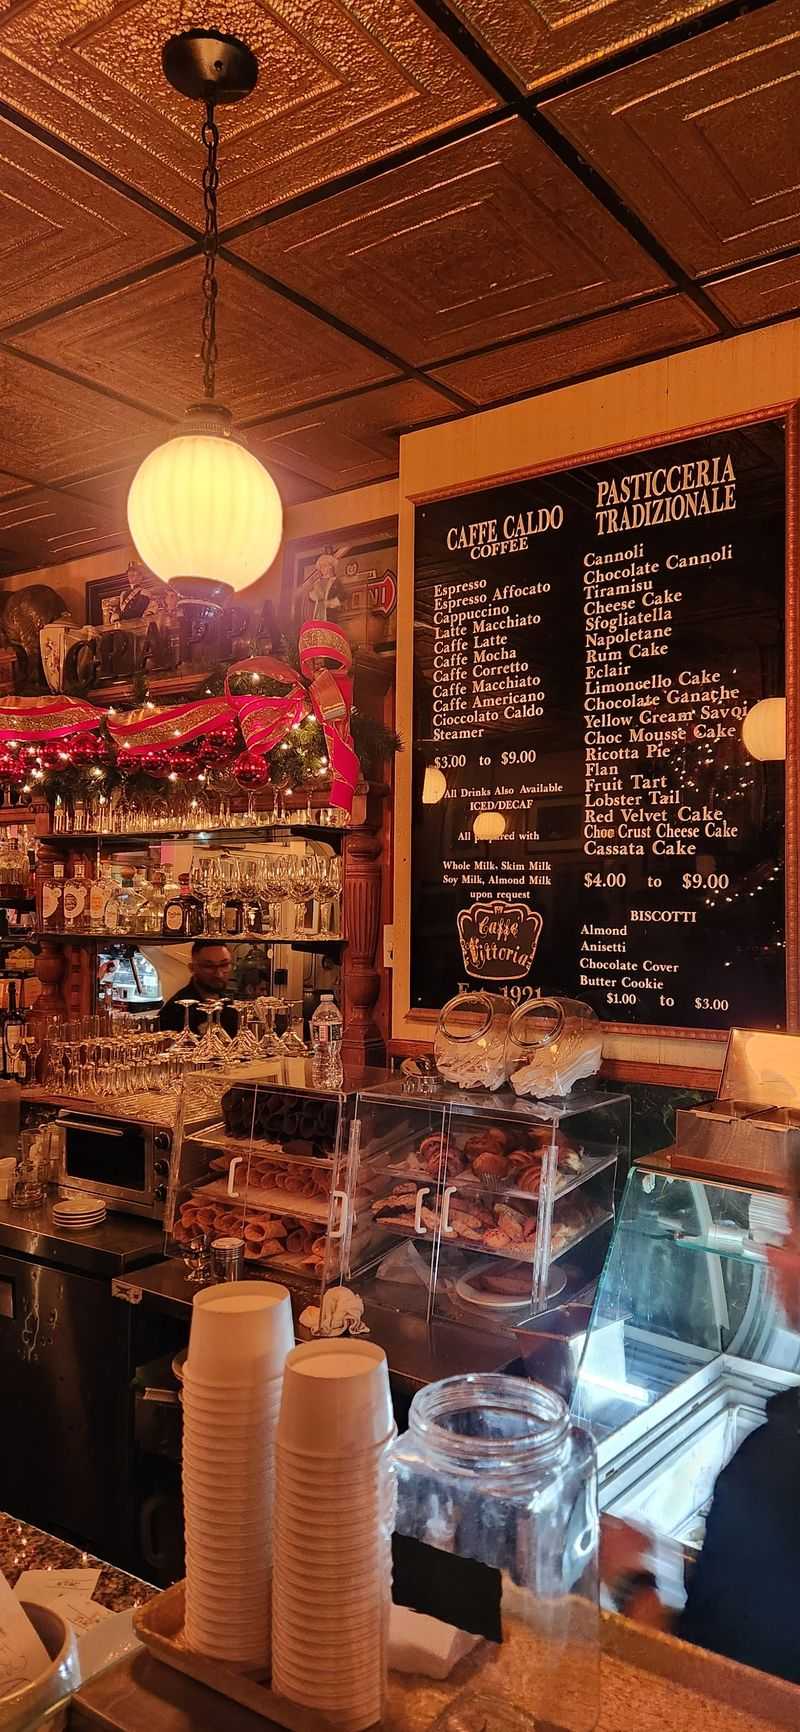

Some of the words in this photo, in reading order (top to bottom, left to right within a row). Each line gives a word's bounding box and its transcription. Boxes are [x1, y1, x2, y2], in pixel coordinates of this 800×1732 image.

[596, 454, 736, 508] PASTICCERIA
[595, 484, 736, 535] TRADIZIONALE
[447, 520, 497, 550] CAFFE
[503, 505, 563, 539] CALDO
[470, 537, 528, 559] COFFEE
[584, 543, 644, 567] Cannoli
[584, 562, 660, 585] Chocolate
[666, 544, 733, 570] Cannoli
[434, 580, 486, 599] Espresso
[434, 594, 487, 613] Espresso
[492, 582, 550, 600] Affocato
[584, 579, 653, 600] Tiramisu
[584, 600, 635, 616] Cheese
[642, 590, 682, 607] Cake
[434, 604, 509, 627] Cappuccino
[585, 607, 673, 633] Sfogliatella
[435, 626, 467, 639] Latte
[473, 614, 541, 633] Macchiato
[434, 638, 468, 654] Caffe
[474, 635, 507, 648] Latte
[585, 626, 673, 650] Napoletane
[433, 653, 468, 668] Caffe
[473, 648, 516, 663] Mocha
[586, 650, 622, 664] Rum
[629, 642, 668, 658] Cake
[433, 668, 467, 682] Caffe
[472, 662, 529, 677] Corretto
[585, 662, 631, 680] Eclair
[433, 683, 467, 698] Caffe
[472, 675, 540, 693] Macchiato
[585, 674, 672, 695] Limoncello
[678, 669, 721, 686] Cake
[433, 698, 467, 712] Caffe
[472, 692, 545, 708] Americano
[584, 694, 660, 712] Chocolate
[666, 685, 740, 704] Ganache
[433, 711, 499, 726] Cioccolato
[504, 704, 543, 719] Caldo
[584, 713, 633, 729] Yellow
[639, 710, 693, 725] Cream
[433, 728, 484, 741] Steamer
[584, 731, 622, 745] Choc
[629, 728, 687, 743] Mousse
[694, 723, 736, 739] Cake
[434, 755, 466, 768] $3.00
[480, 756, 491, 766] to
[501, 750, 536, 765] $9.00
[585, 747, 639, 762] Ricotta
[646, 744, 671, 759] Pie
[585, 763, 619, 777] Flan
[444, 789, 457, 798] All
[461, 788, 491, 797] Drinks
[495, 786, 514, 795] Also
[520, 783, 563, 793] Available
[585, 777, 623, 793] Fruit
[630, 774, 668, 790] Tart
[470, 800, 533, 810] ICED/DECAF
[584, 794, 642, 807] Lobster
[648, 790, 680, 805] Tail
[584, 809, 614, 823] Red
[620, 808, 668, 822] Velvet
[677, 806, 724, 822] Cake
[458, 832, 470, 840] All
[519, 831, 539, 840] with
[584, 824, 615, 839] Choc
[618, 823, 652, 838] Crust
[656, 823, 700, 838] Cheese
[705, 822, 738, 838] Cake
[584, 840, 645, 856] Cassata
[652, 840, 697, 855] Cake
[443, 861, 470, 870] Whole
[501, 861, 524, 870] Skim
[529, 861, 551, 870] Milk
[443, 875, 458, 886] Soy
[488, 876, 525, 885] Almond
[529, 876, 551, 885] Milk
[584, 872, 626, 888] $4.00
[647, 876, 662, 888] to
[682, 873, 729, 889] $9.00
[470, 892, 492, 900] upon
[497, 891, 530, 901] request
[630, 910, 697, 923] BISCOTTI
[580, 924, 628, 936] Almond
[580, 941, 626, 953] Anisetti
[579, 957, 638, 971] Chocolate
[642, 960, 679, 973] Cover
[579, 975, 617, 987] Butter
[621, 976, 664, 990] Cookie
[501, 985, 542, 1005] 1921
[606, 992, 637, 1005] $1.00
[659, 994, 675, 1007] to
[694, 997, 729, 1011] $3.00
